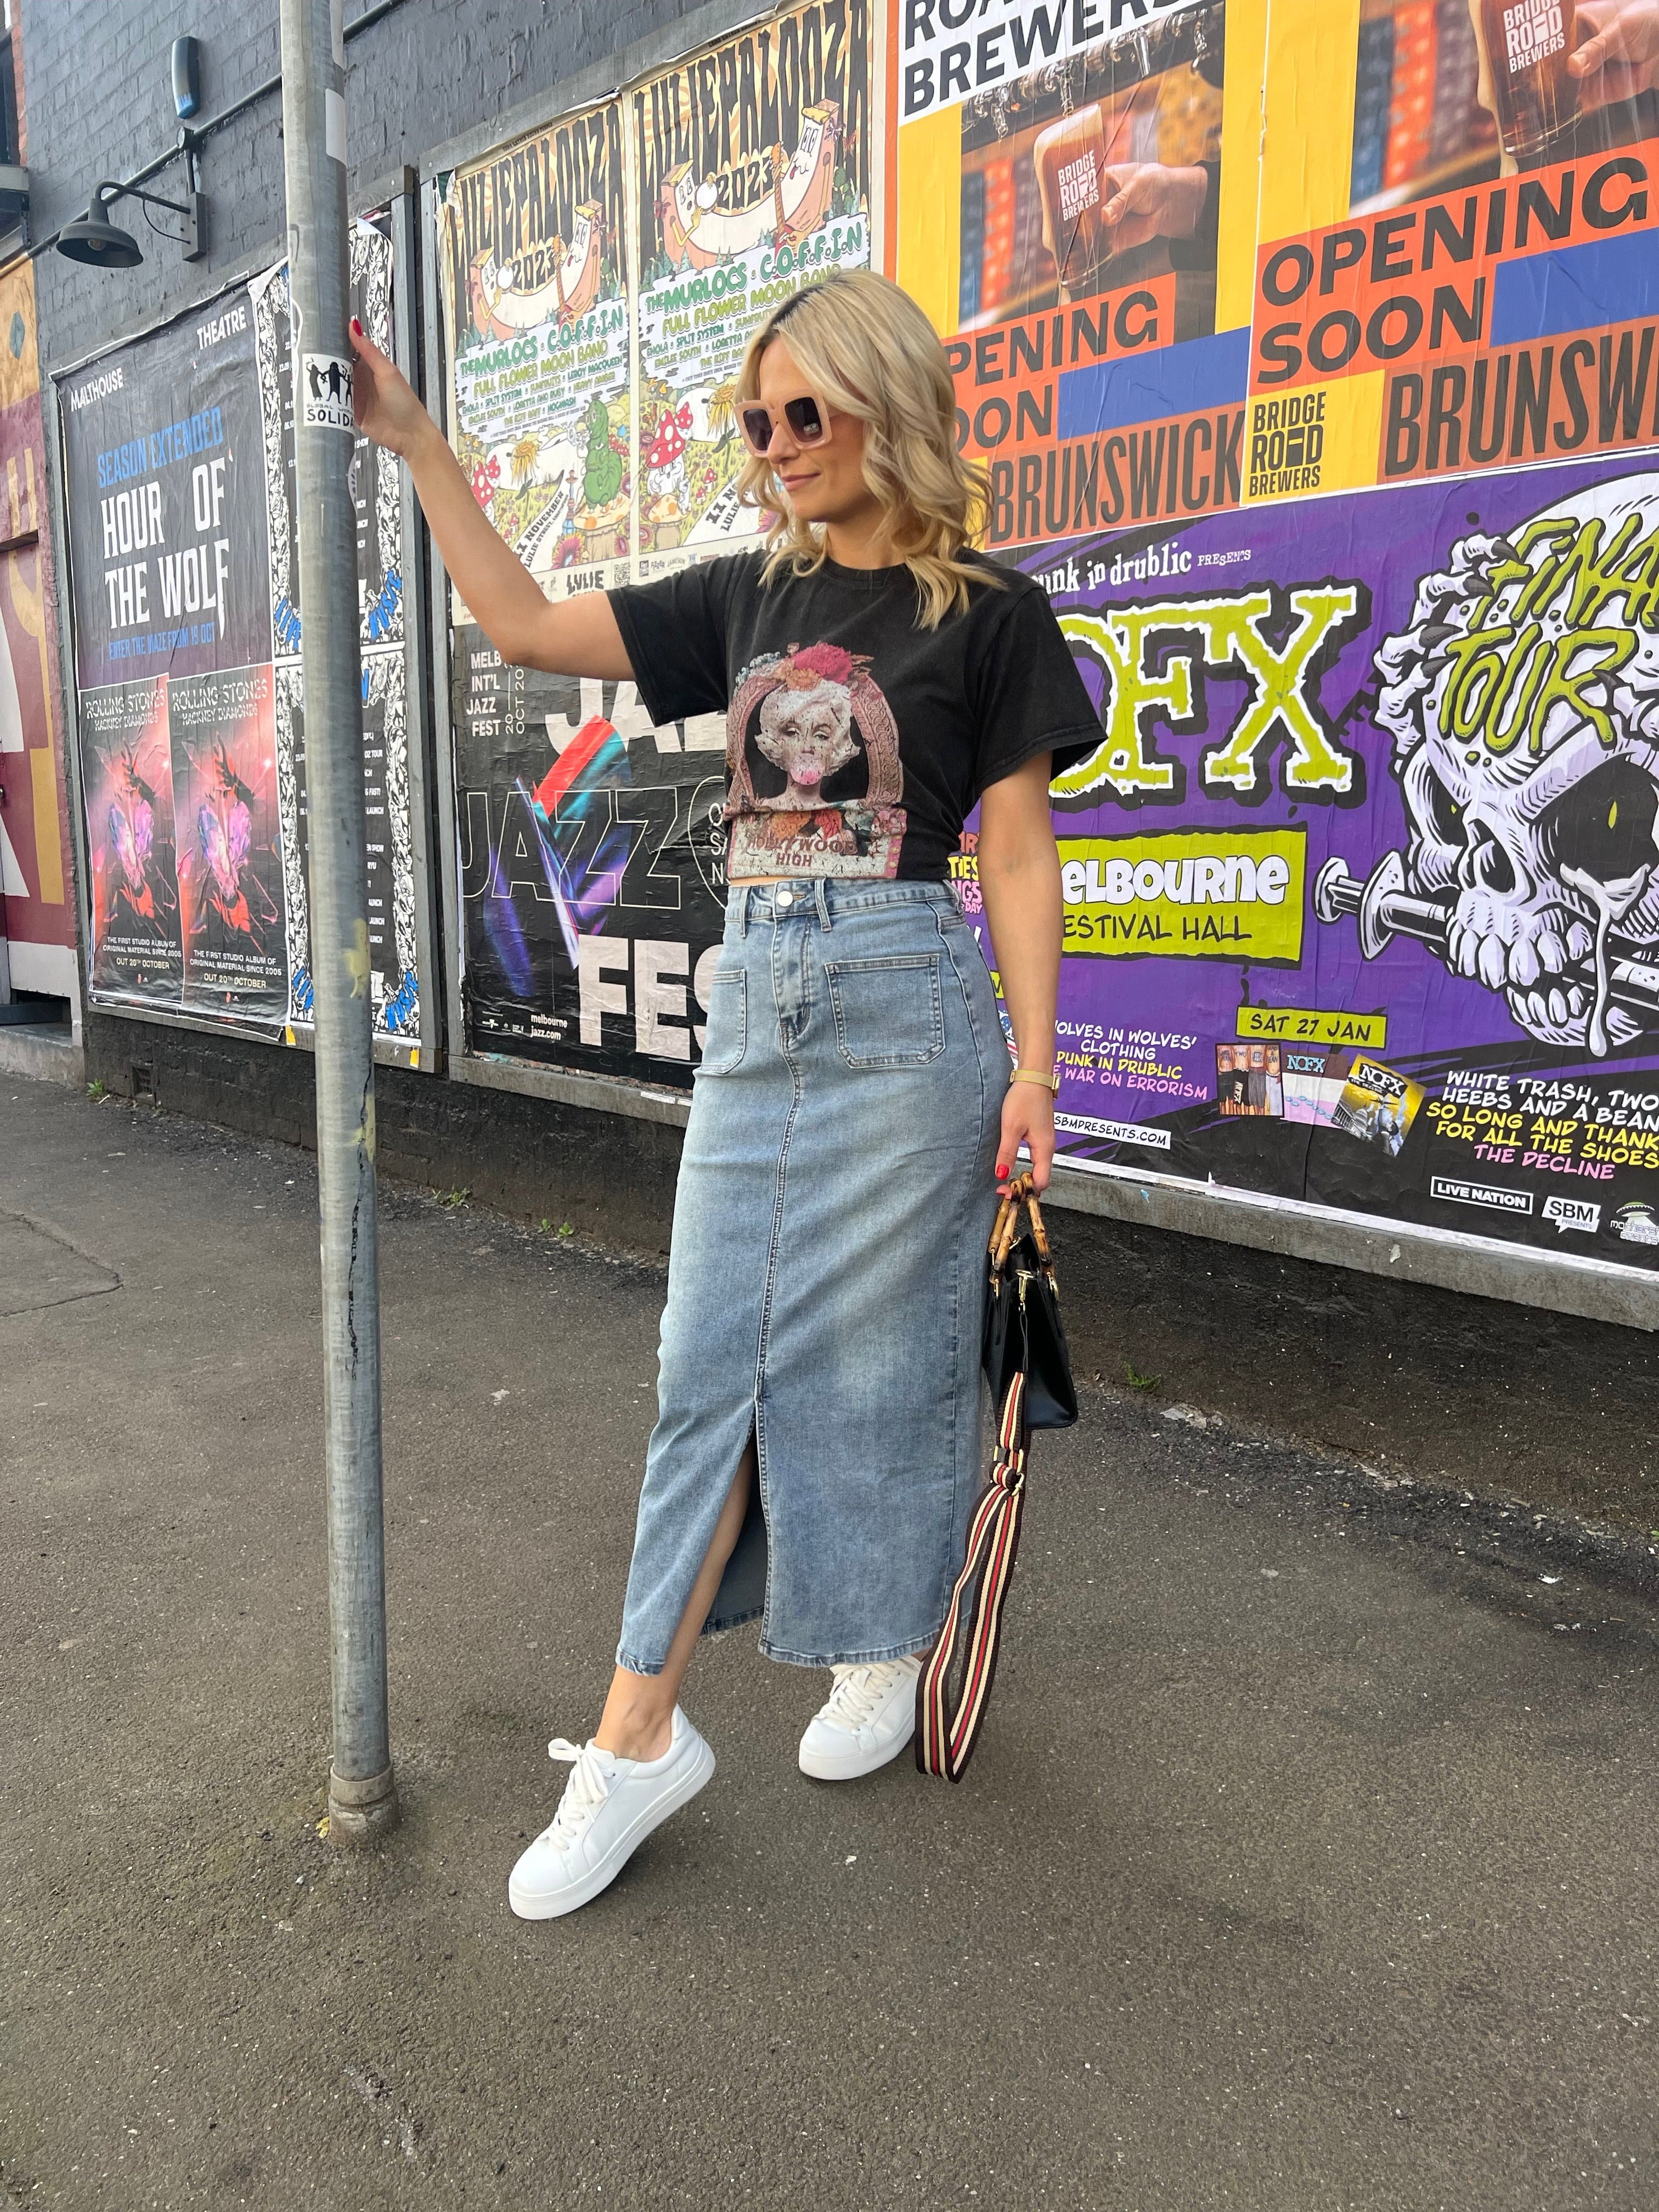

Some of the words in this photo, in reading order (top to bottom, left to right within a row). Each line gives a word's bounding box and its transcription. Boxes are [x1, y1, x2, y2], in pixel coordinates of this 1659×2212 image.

[904, 0, 1174, 116] BREWER
[1508, 31, 1565, 74] BREWERS
[1058, 150, 1095, 187] BRIDGE
[1062, 188, 1099, 222] BREWERS
[1261, 156, 1648, 307] OPENING
[646, 296, 664, 313] THE
[663, 262, 747, 314] MURLOCS
[662, 315, 690, 338] FULL
[694, 294, 747, 328] FLOWER
[750, 279, 797, 308] MOON
[197, 306, 246, 349] THEATRE
[697, 324, 724, 341] SYSTEM
[944, 290, 1159, 386] PENING
[1257, 276, 1486, 385] SOON
[460, 359, 475, 376] THE
[474, 335, 538, 377] MURLOCS
[473, 381, 496, 398] FULL
[499, 363, 538, 387] FLOWER
[540, 349, 574, 374] MOON
[577, 340, 608, 365] BAND
[70, 368, 123, 411] MALTHOUSE
[1385, 326, 1659, 477] BRUNSW
[1253, 391, 1327, 432] BRIDGE
[98, 446, 149, 489] SEASON
[151, 407, 223, 469] EXTENDED
[990, 410, 1246, 544] BRUNSWICK
[1249, 465, 1321, 495] BREWERS
[100, 481, 165, 559] HOUR
[192, 456, 226, 532] OF
[524, 490, 565, 541] NOVEMBER
[720, 501, 741, 532] LULIE
[524, 541, 539, 568] LULIE
[1031, 556, 1080, 595] unk
[1086, 560, 1106, 590] in
[1110, 541, 1193, 586] drublic
[1197, 549, 1251, 567] PRESENTS
[1466, 512, 1659, 630] FINA
[104, 563, 150, 629] THE
[158, 538, 229, 641] WOLF
[566, 570, 604, 595] LULIE
[109, 640, 131, 661] ENTER
[131, 636, 146, 656] THE
[146, 632, 167, 654] MAZE
[167, 628, 189, 651] FROM
[190, 627, 199, 646] 19
[200, 622, 216, 644] OCT
[470, 650, 501, 670] MELB
[172, 687, 218, 712] ROLLING
[220, 678, 268, 701] STONES
[471, 674, 500, 692] INT'L
[1048, 585, 1357, 799] OFX
[1438, 622, 1639, 757] TOUR
[86, 697, 125, 721] ROLLING
[127, 687, 166, 712] STONES
[95, 715, 122, 731] HACKNEY
[124, 710, 159, 727] DIAMONDS
[182, 709, 216, 726] HACKNEY
[217, 703, 258, 722] DIAMONDS
[466, 697, 496, 715] JAZZ
[516, 700, 525, 735] OCT
[472, 719, 501, 737] FEST
[505, 713, 514, 735] 20
[462, 787, 682, 910] JAZZ
[747, 836, 858, 855] HOLLYWOOD
[776, 853, 812, 867] HIGH
[1060, 855, 1290, 906] eLBOURne
[965, 901, 983, 915] DAY
[107, 936, 117, 944] THE
[117, 936, 131, 945] FIRST
[132, 938, 150, 946] STUDIO
[151, 939, 168, 949] ALBUM
[1063, 913, 1173, 941] ESTIVAL
[1183, 916, 1252, 943] HALL
[103, 944, 127, 953] ORIGINAL
[127, 946, 152, 955] MATERIAL
[152, 948, 167, 956] SINCE
[167, 950, 182, 958] 2005
[116, 957, 129, 966] OUT
[129, 959, 142, 967] 20TH
[142, 961, 170, 970] OCTOBER
[190, 958, 216, 970] ORIGINAL
[217, 961, 246, 972] MATERIAL
[246, 964, 264, 974] SINCE
[265, 967, 282, 977] 2005
[194, 950, 205, 958] THE
[205, 950, 222, 960] FIRST
[223, 952, 245, 963] STUDIO
[245, 955, 267, 966] ALBUM
[267, 957, 276, 966] OF
[204, 973, 218, 983] OUT
[219, 975, 233, 985] 20TH
[234, 976, 267, 989] OCTOBER
[530, 1025, 562, 1041] jazz.com
[531, 1013, 568, 1029] melbourne
[1055, 1020, 1104, 1039] OLVES
[1108, 1028, 1124, 1042] IN
[1127, 1029, 1198, 1050] WOLVES'
[1250, 1013, 1290, 1033] SAT
[1296, 1018, 1319, 1036] 27
[1327, 1019, 1371, 1042] JAN
[1056, 1051, 1094, 1068] PUNK
[1098, 1056, 1114, 1070] IN
[1118, 1058, 1183, 1080] DRUBLIC
[1080, 1039, 1156, 1060] CLOTHING
[1286, 1054, 1327, 1074] NOFX
[1064, 1067, 1096, 1084] WAR
[1099, 1072, 1122, 1087] ON
[1126, 1074, 1207, 1101] ERRORISM
[1359, 1064, 1406, 1096] NOFX
[1446, 1070, 1511, 1091] WHITE
[1517, 1077, 1599, 1107] TRASH,
[1607, 1090, 1659, 1110] TWO
[1426, 1101, 1457, 1120] SO
[1462, 1105, 1523, 1129] LONG
[1530, 1116, 1578, 1137] AND
[1442, 1086, 1513, 1110] HEEBS
[1519, 1096, 1567, 1116] AND
[1573, 1103, 1588, 1122] A
[1595, 1107, 1659, 1132] BEAN
[1435, 1120, 1476, 1142] FOR
[1482, 1127, 1523, 1147] ALL
[1530, 1134, 1573, 1154] THE
[1579, 1142, 1659, 1170] SHOES
[1473, 1144, 1516, 1164] THE
[1521, 1151, 1616, 1180] DECLINE
[1437, 1182, 1470, 1199] LIVE
[1471, 1186, 1527, 1209] NATION
[1549, 1200, 1594, 1223] SBM
[1561, 1218, 1593, 1230] PRESENTS
